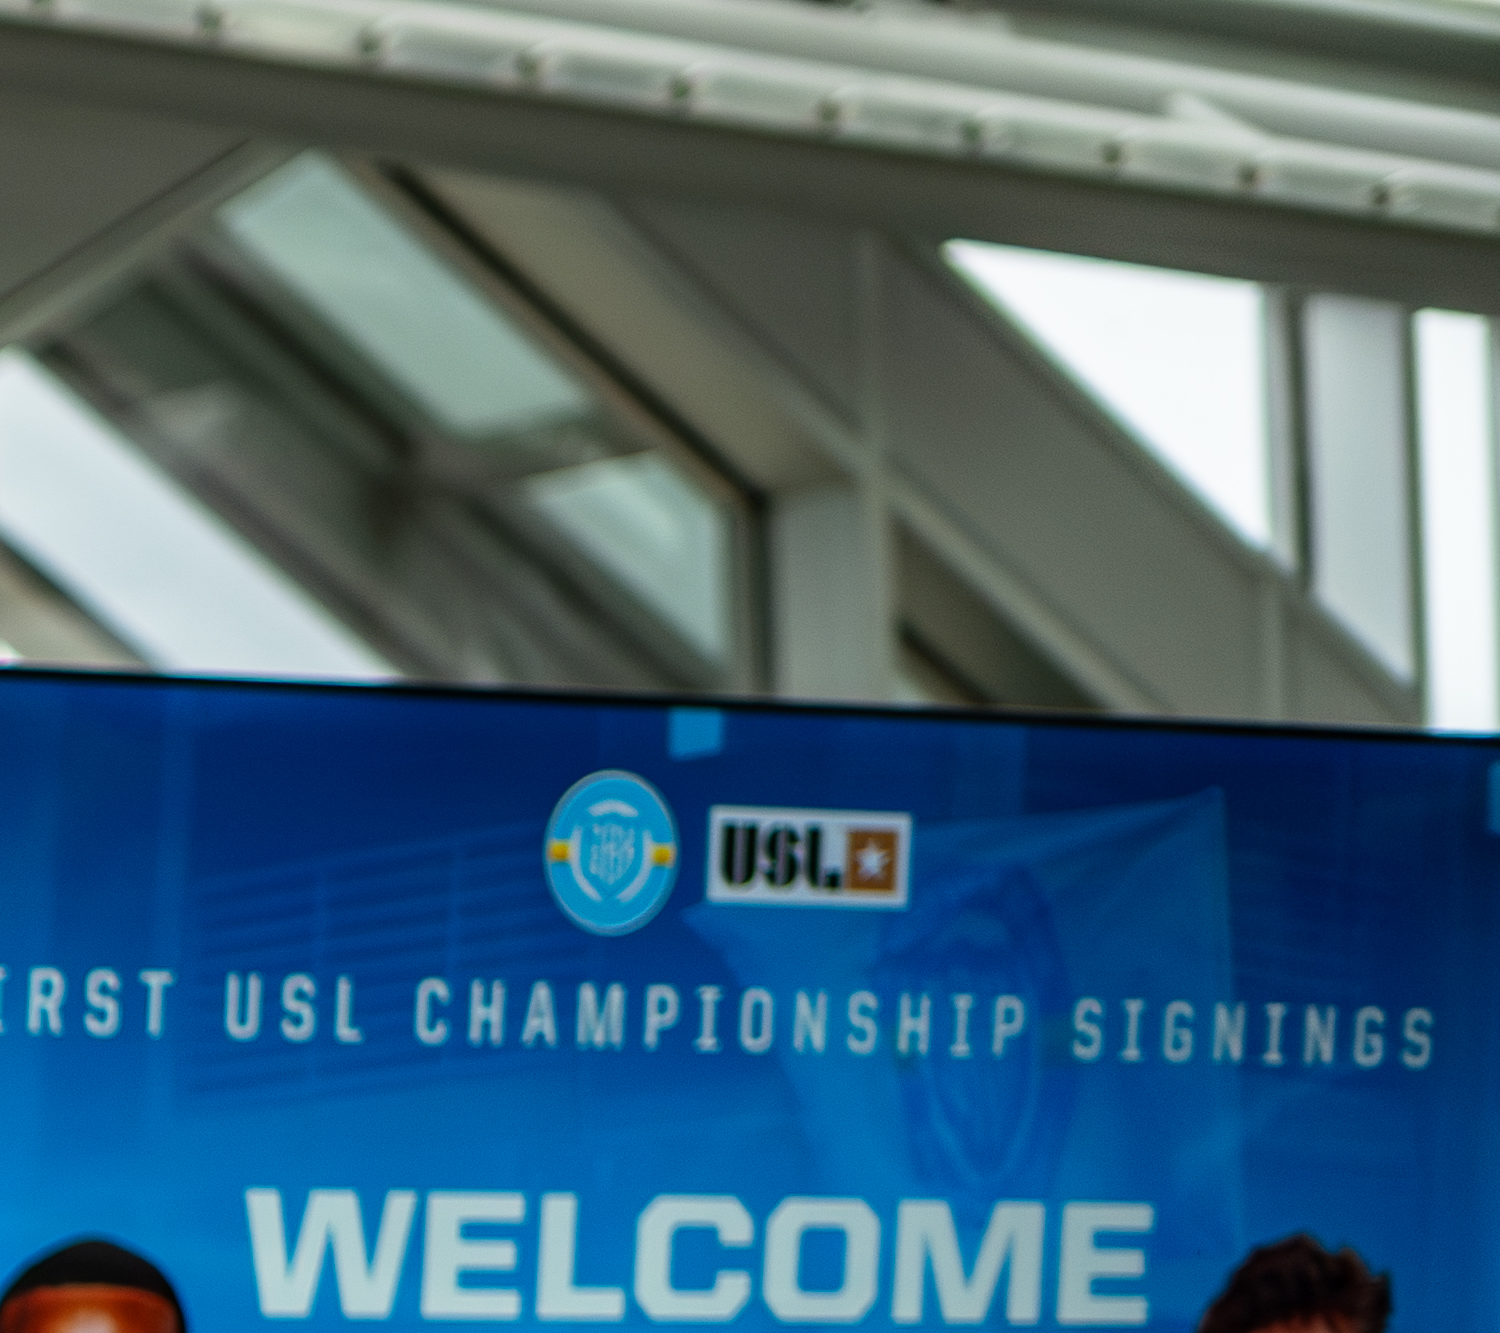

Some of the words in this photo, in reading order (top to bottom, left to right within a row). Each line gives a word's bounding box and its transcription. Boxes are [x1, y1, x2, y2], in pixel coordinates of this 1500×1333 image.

[720, 820, 842, 891] USL
[225, 971, 364, 1045] USL
[413, 976, 1026, 1058] CHAMPIONSHIP
[1071, 998, 1433, 1069] SIGNINGS
[245, 1188, 1154, 1324] WELCOME
